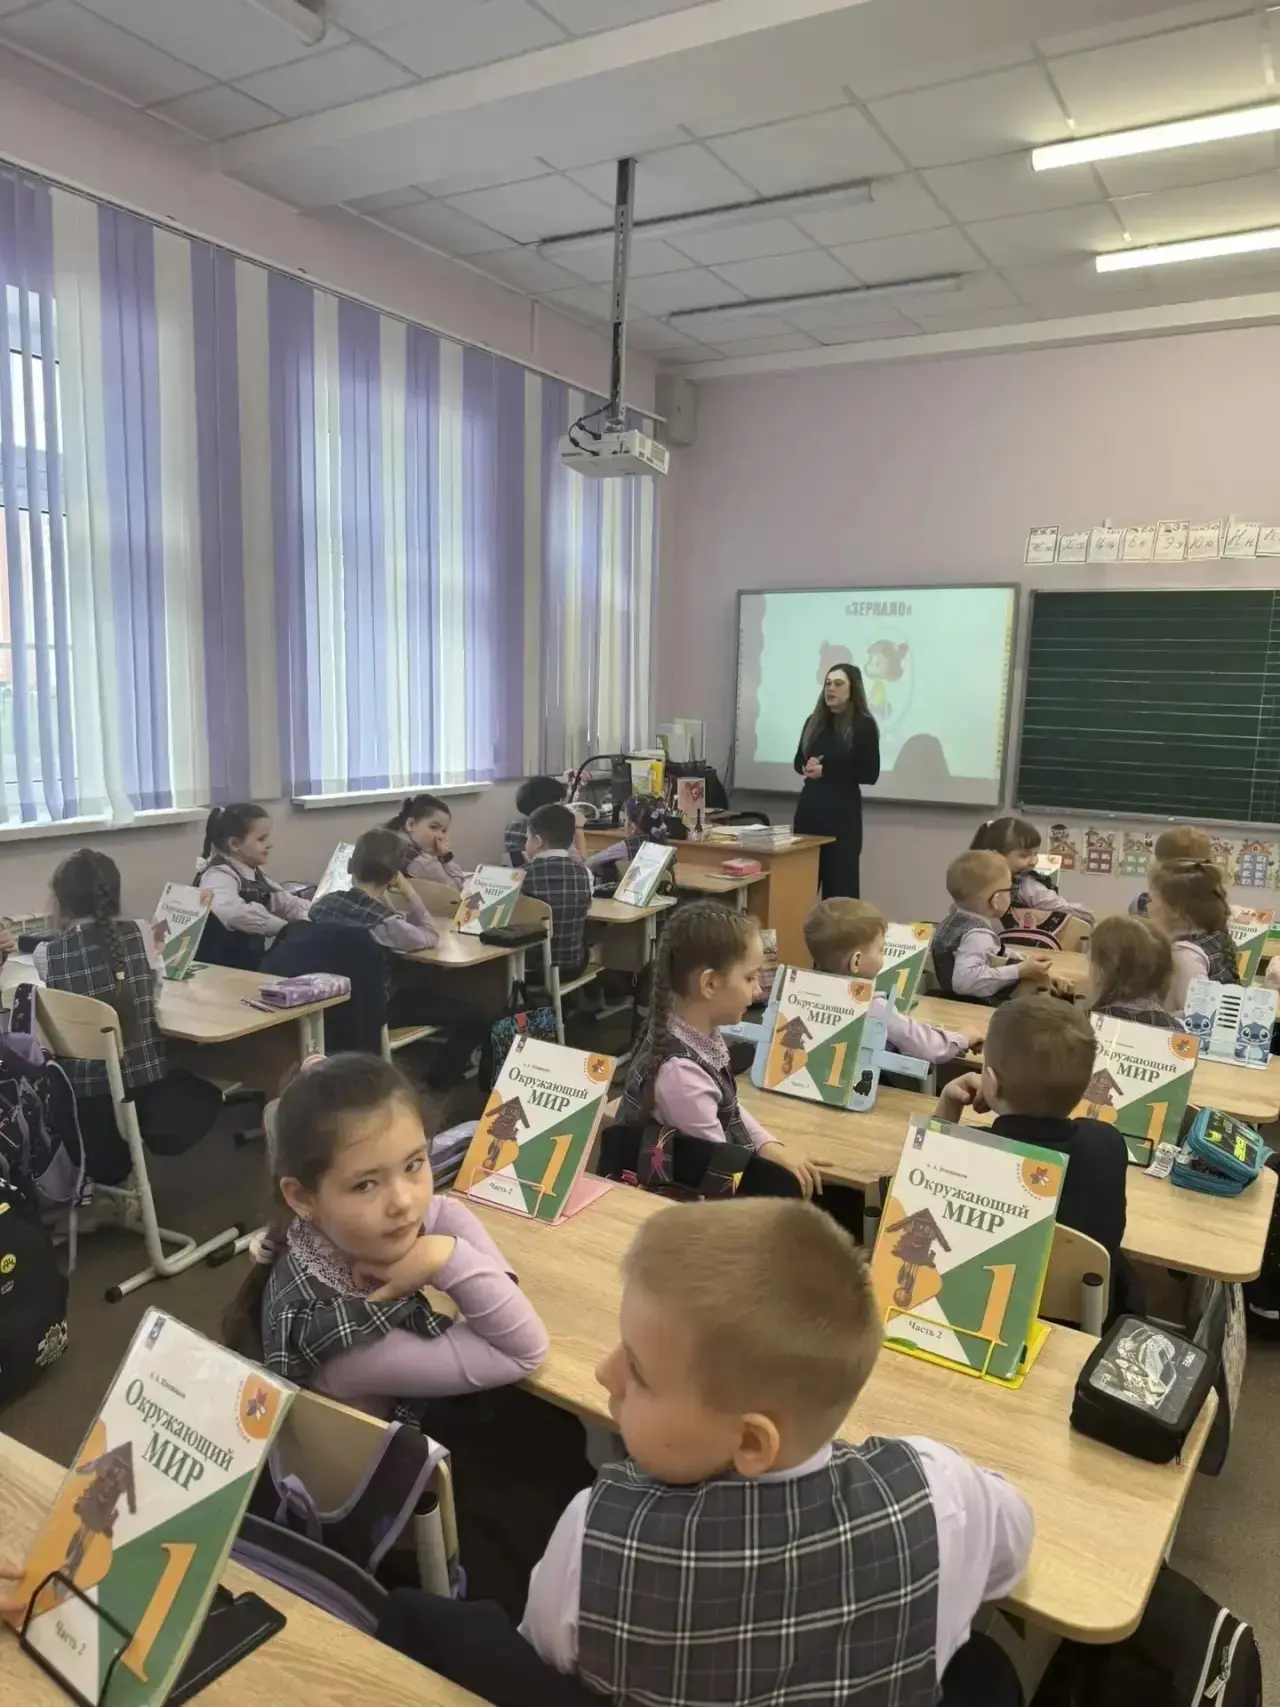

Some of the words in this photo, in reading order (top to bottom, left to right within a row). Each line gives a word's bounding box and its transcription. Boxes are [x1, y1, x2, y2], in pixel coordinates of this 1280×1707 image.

[896, 968, 911, 999] 1
[788, 993, 855, 1016] Окружающий
[807, 1010, 842, 1026] МИР
[823, 1041, 848, 1088] 1
[1116, 1062, 1160, 1083] МИР
[508, 1066, 589, 1099] Окружающий
[527, 1089, 570, 1112] МИР
[1137, 1101, 1168, 1149] 1
[531, 1133, 573, 1197] 1
[908, 1167, 1030, 1219] Окружающий
[941, 1200, 1005, 1234] МИР
[976, 1264, 1017, 1347] 1
[908, 1319, 935, 1338] Часть
[936, 1331, 943, 1339] 2
[125, 1379, 234, 1472] Окружающий
[141, 1430, 205, 1491] МИР
[119, 1542, 197, 1685] 1
[78, 1642, 87, 1657] 2
